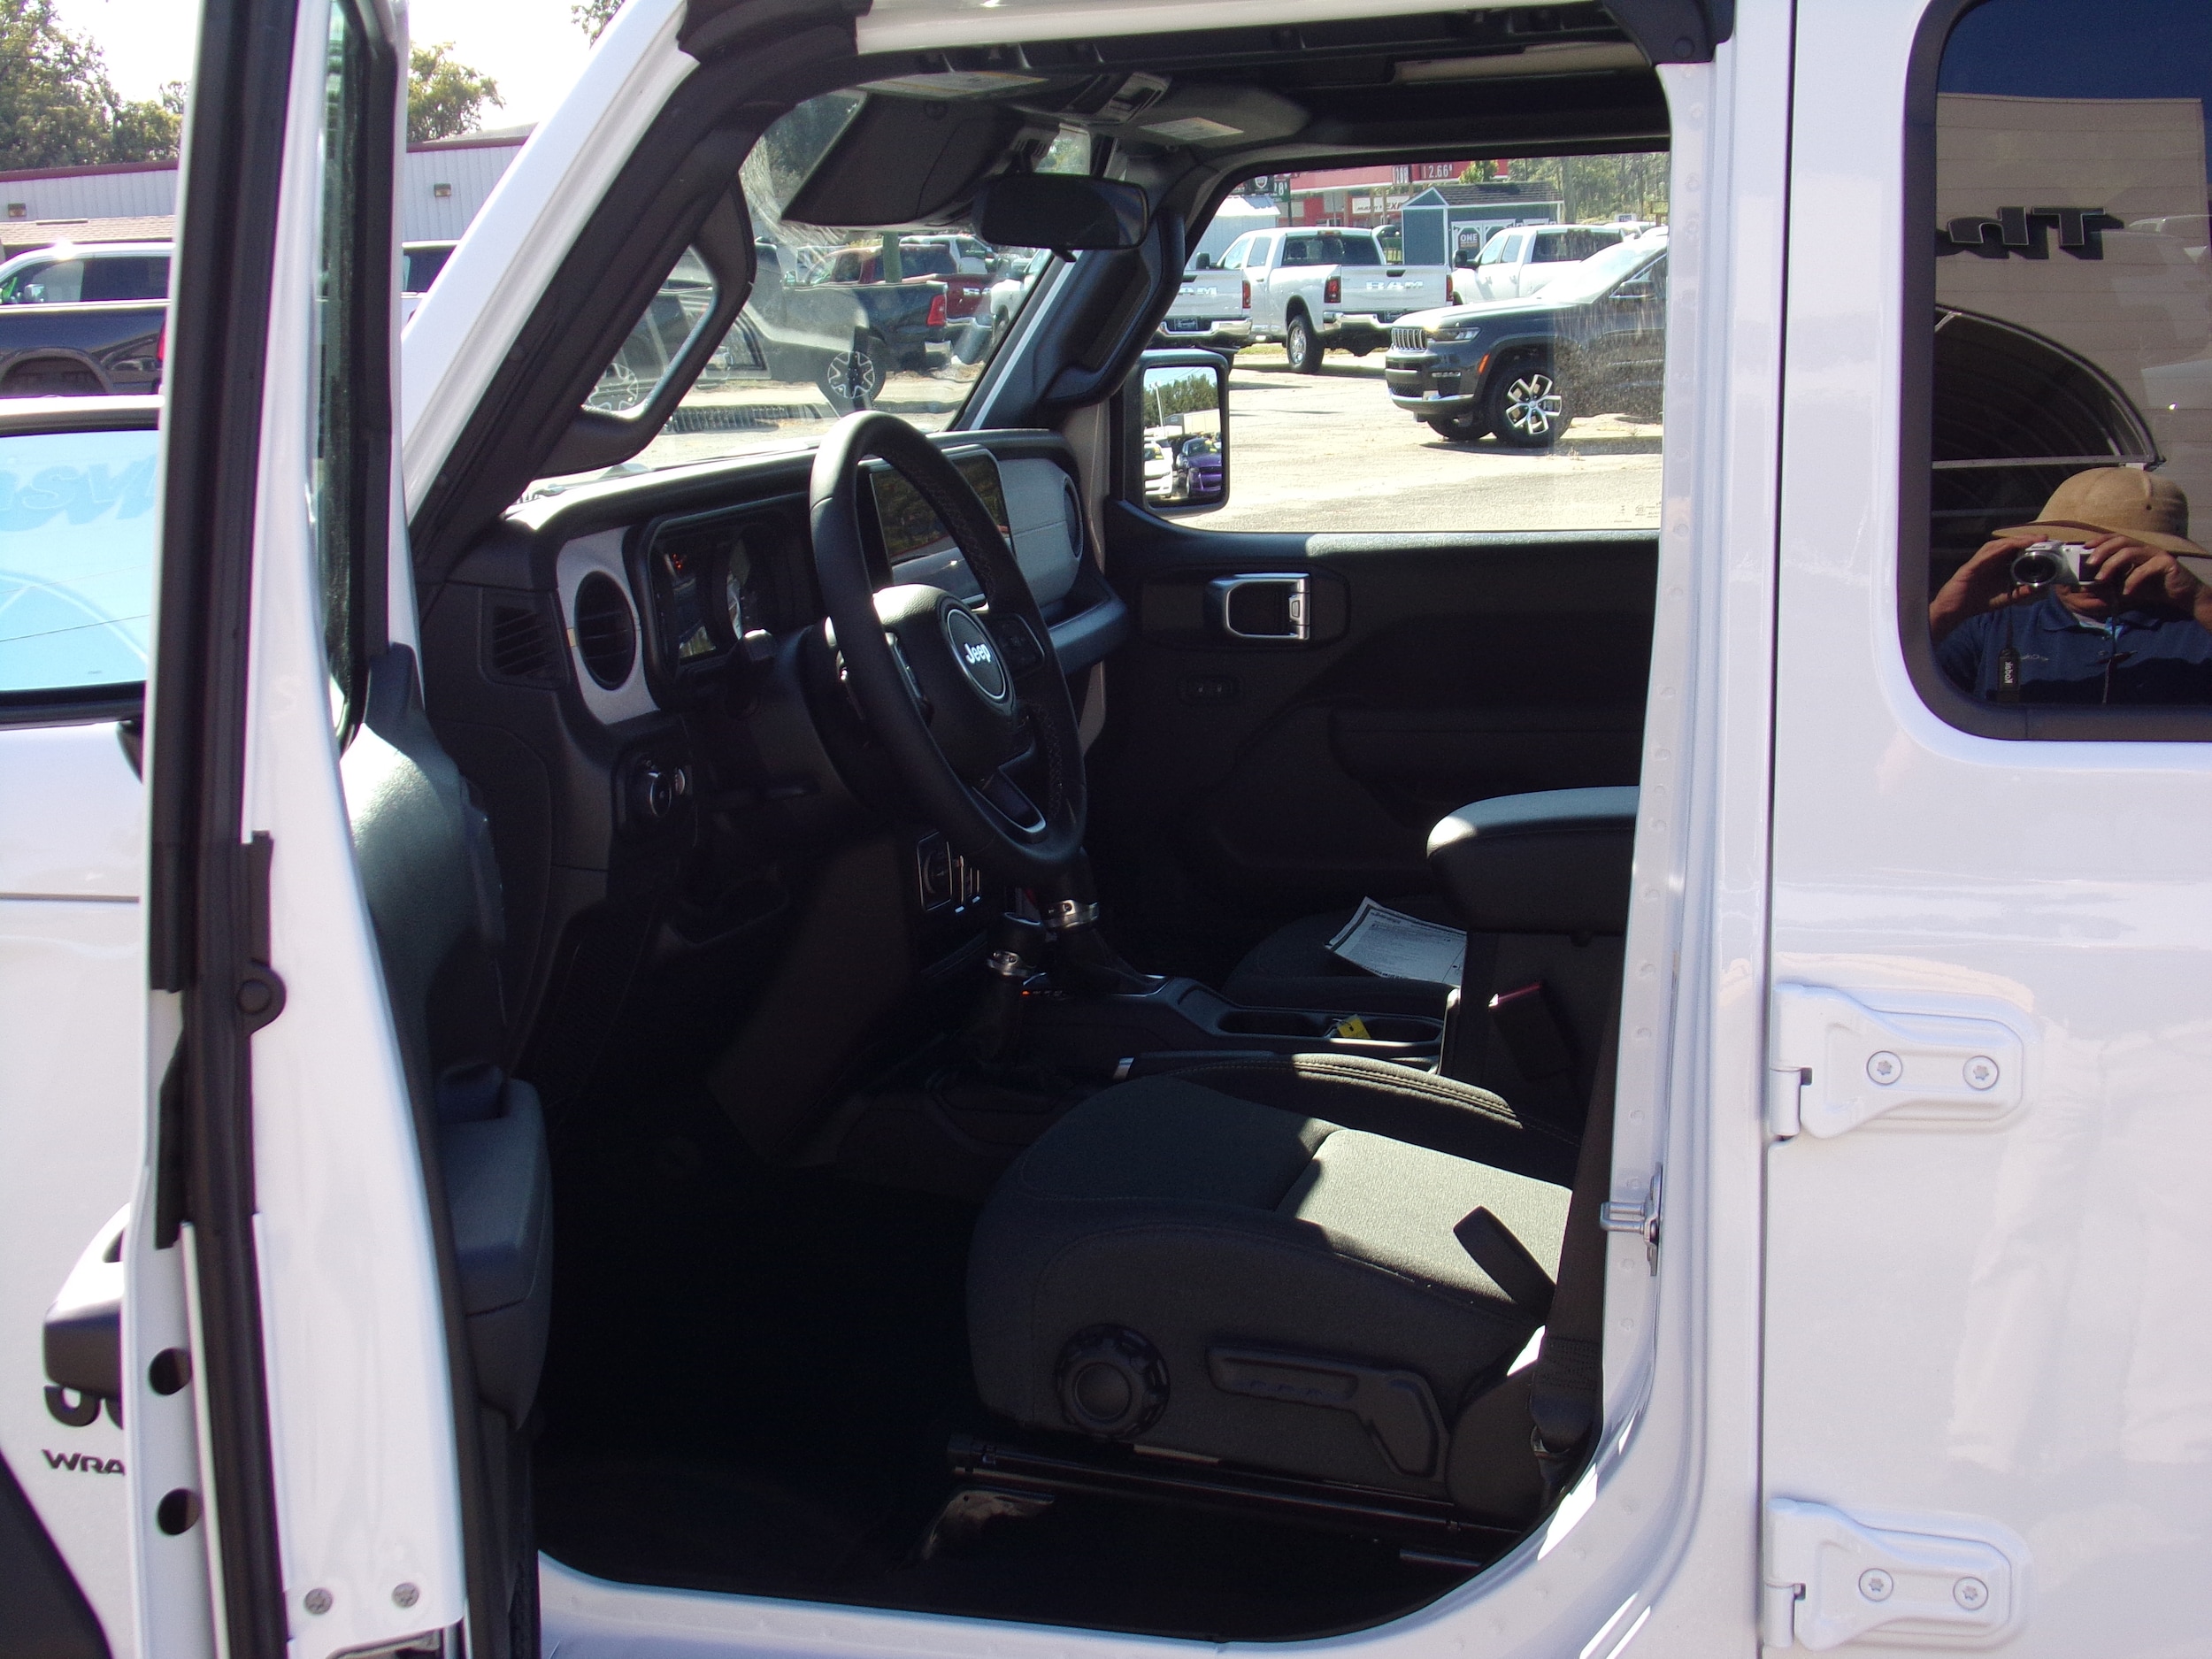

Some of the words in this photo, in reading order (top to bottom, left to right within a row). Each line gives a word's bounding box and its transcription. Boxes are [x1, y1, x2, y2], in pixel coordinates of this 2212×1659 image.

[1460, 233, 1478, 242] ONE
[1365, 280, 1424, 291] RAM
[964, 642, 991, 664] Jeep
[41, 1448, 126, 1476] WRA
